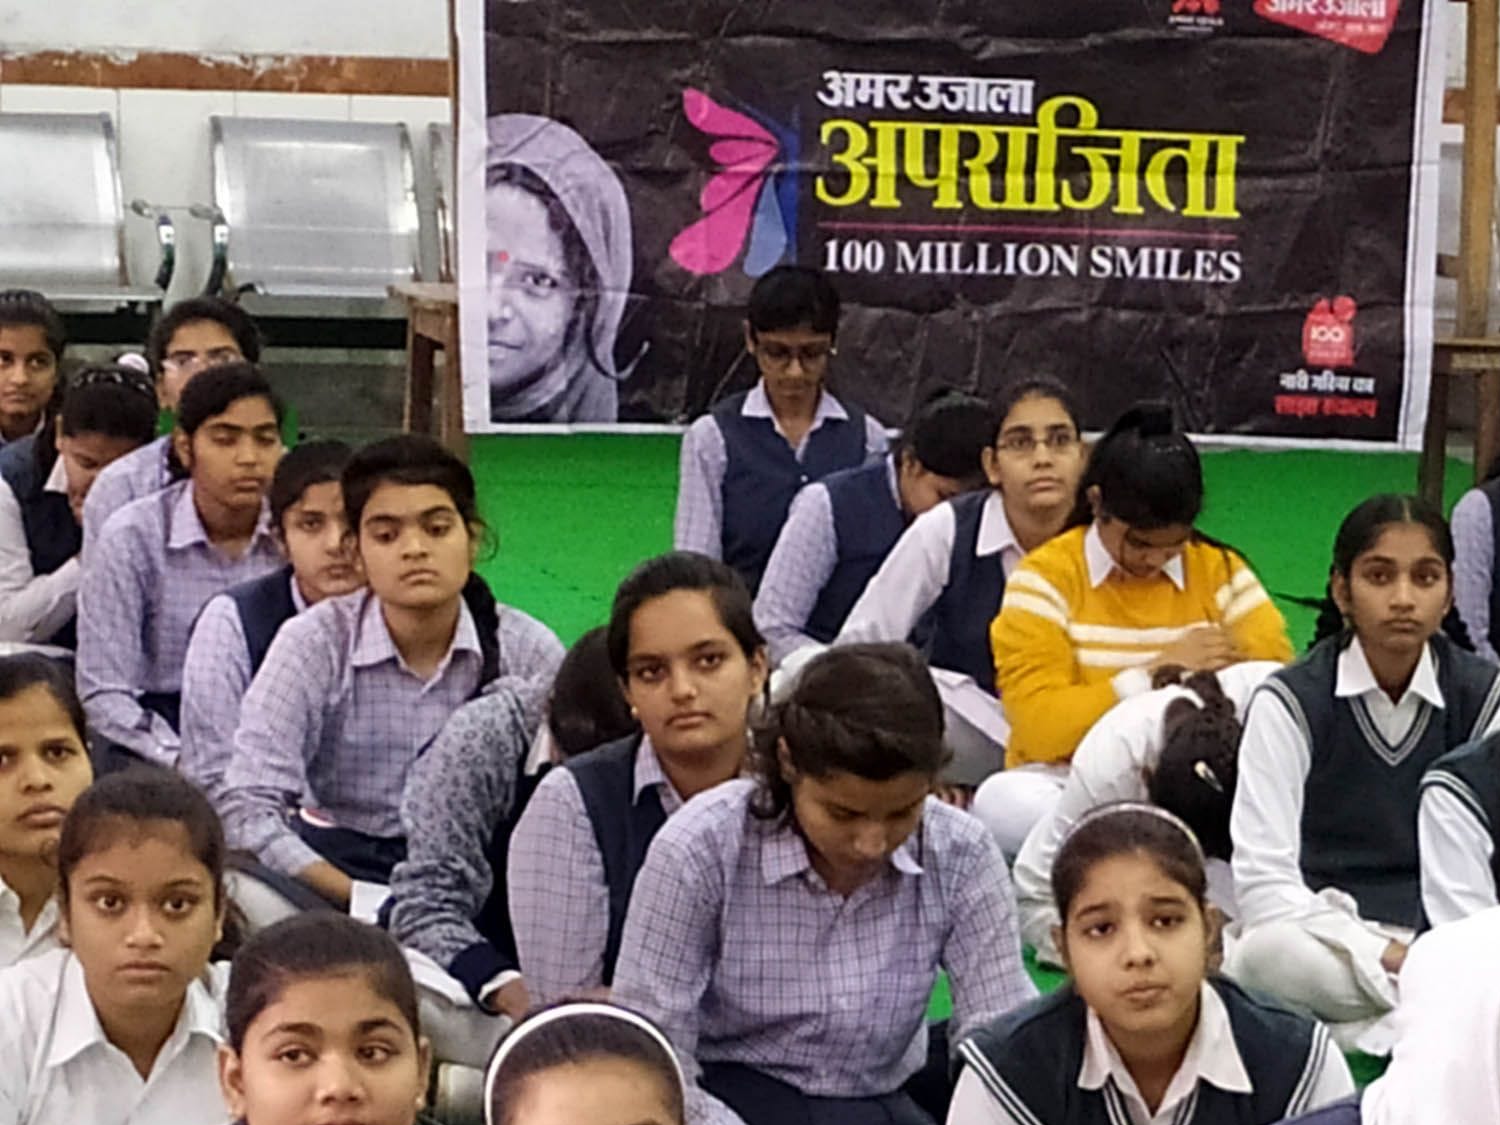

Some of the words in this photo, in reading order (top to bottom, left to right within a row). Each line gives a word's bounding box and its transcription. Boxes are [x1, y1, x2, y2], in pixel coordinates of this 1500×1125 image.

[817, 70, 913, 110] अमर
[914, 74, 1035, 115] उजाला
[815, 96, 1246, 219] अपराजिता
[823, 239, 885, 274] 100
[895, 240, 1080, 277] MILLION
[1090, 246, 1242, 283] SMILES
